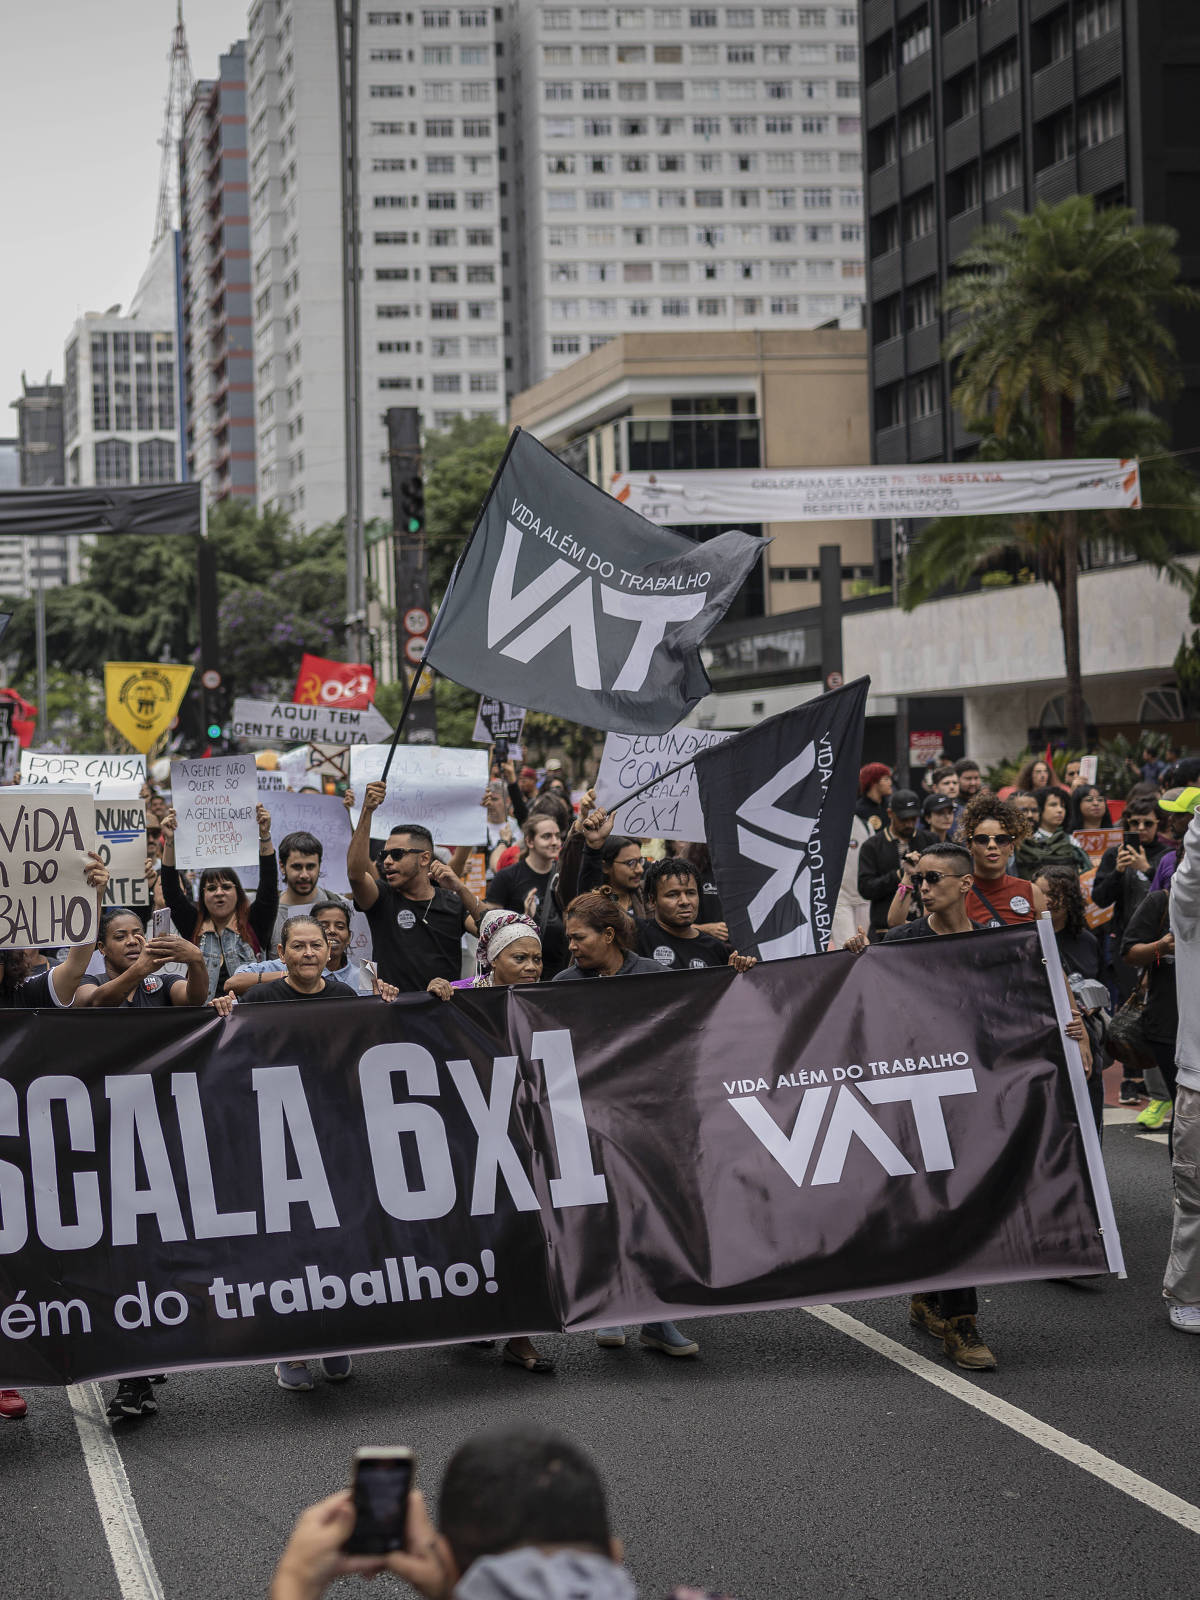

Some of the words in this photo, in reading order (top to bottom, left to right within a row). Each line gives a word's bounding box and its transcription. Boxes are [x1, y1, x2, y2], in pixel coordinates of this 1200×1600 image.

[751, 477, 825, 489] CICLOFAIXA
[828, 477, 844, 488] DE
[848, 475, 888, 486] LAZER
[939, 472, 979, 484] NESTA
[806, 489, 875, 500] DOMINGOS
[890, 487, 953, 498] FERIADOS
[803, 502, 863, 514] RESPEITE
[867, 502, 876, 512] A
[879, 499, 960, 513] SINALIZAÇÃO
[510, 498, 541, 536] VIDA
[539, 526, 585, 563] ALÉM
[586, 552, 615, 579] DO
[618, 570, 712, 592] TRABALHO
[487, 520, 707, 692] VAT
[271, 706, 318, 722] AQUI
[329, 710, 361, 725] TEM
[233, 722, 285, 738] GENTE
[290, 726, 319, 742] QUE
[322, 727, 368, 745] LUTA
[29, 757, 80, 776] POR
[85, 760, 146, 782] CAUSA
[190, 764, 222, 778] GENTE
[226, 763, 246, 777] NÃO
[188, 780, 214, 792] QUER
[224, 777, 240, 790] SÓ
[96, 808, 146, 832] NUNCA
[185, 808, 194, 820] A
[195, 807, 228, 820] GENTE
[229, 806, 253, 821] QUER
[624, 801, 683, 835] 6X1
[198, 833, 243, 846] DIVERSÃO
[195, 846, 203, 857] E
[808, 839, 825, 871] DO
[22, 858, 59, 885] DO
[723, 1077, 770, 1096] VIDA
[776, 1069, 829, 1089] ALÉM
[833, 1065, 864, 1082] DO
[868, 1051, 970, 1077] TRABALHO
[728, 1068, 978, 1188] VAT
[114, 1280, 189, 1330] do
[209, 1249, 500, 1320] trabalho!
